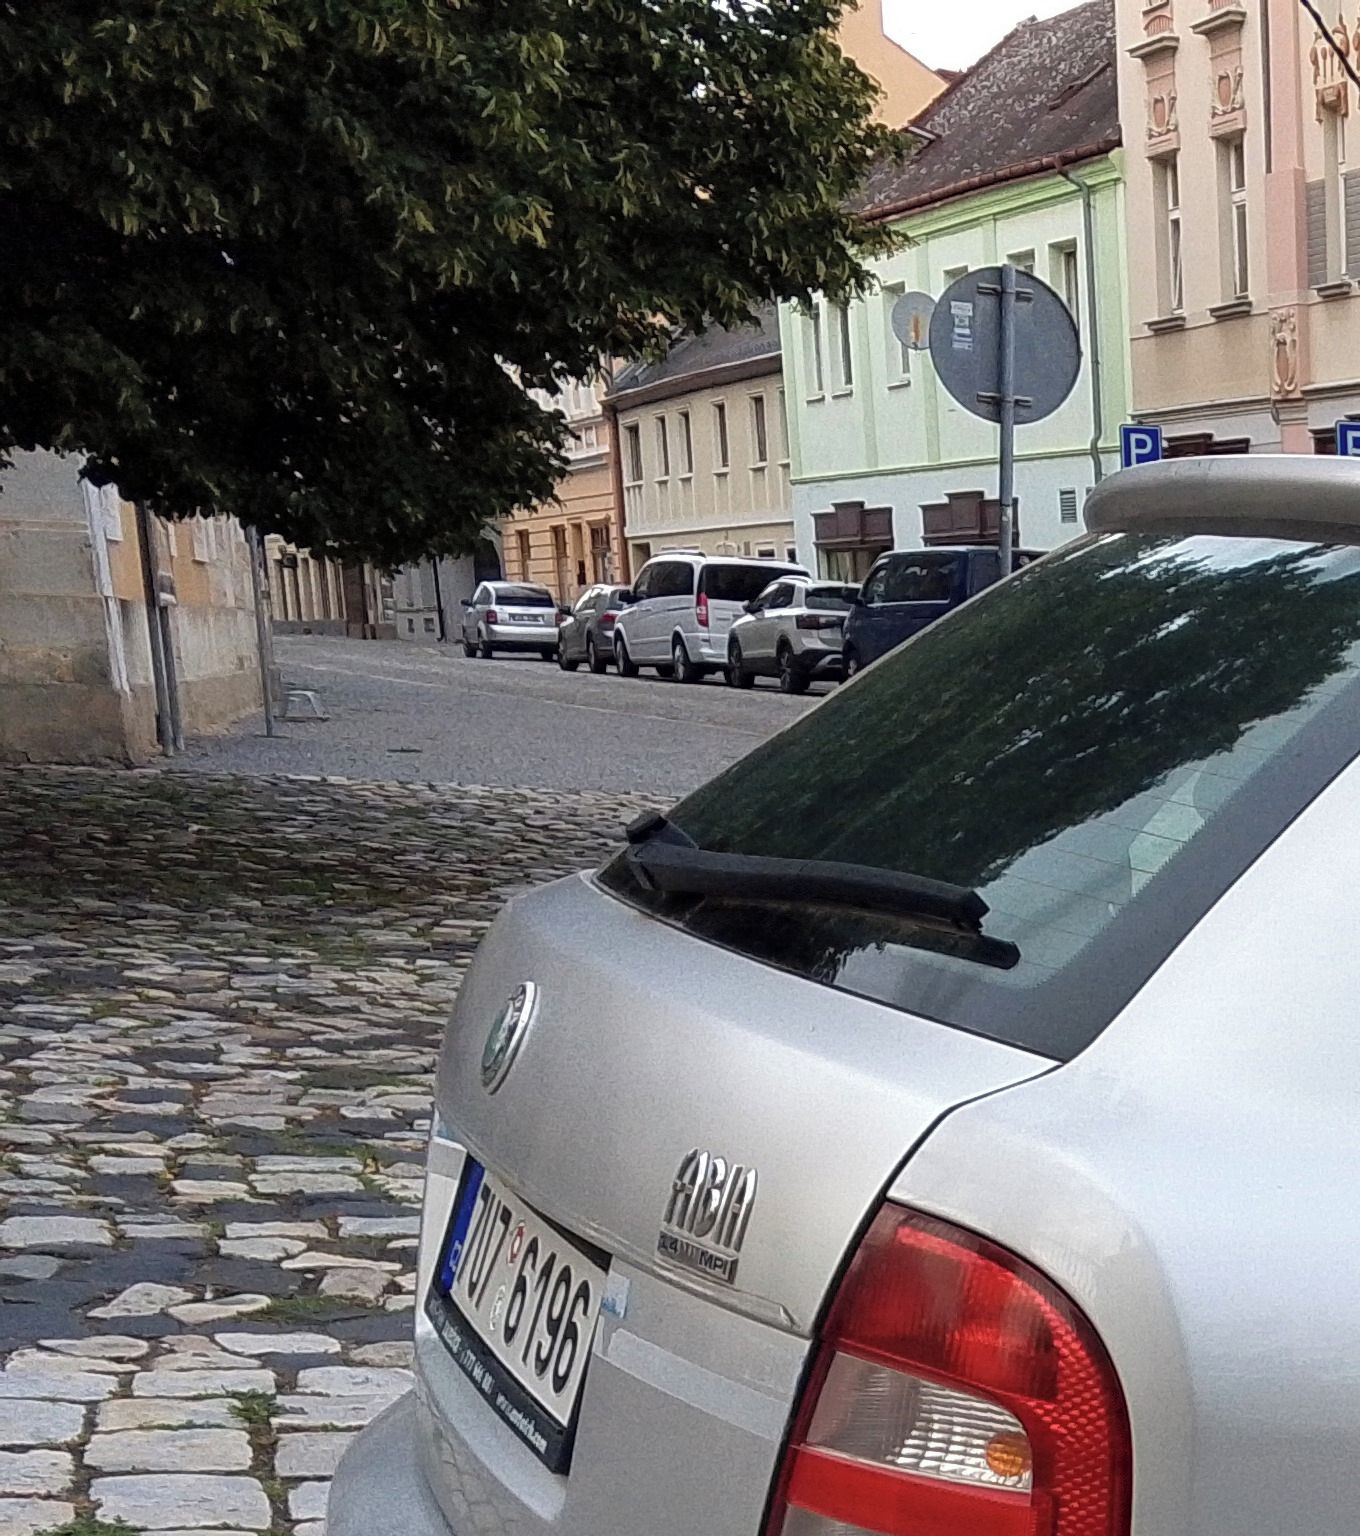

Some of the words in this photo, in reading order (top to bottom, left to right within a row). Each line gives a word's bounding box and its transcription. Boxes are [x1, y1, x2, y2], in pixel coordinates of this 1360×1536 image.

[1129, 432, 1153, 465] P
[699, 1250, 729, 1276] MPI
[456, 1182, 513, 1309] 7U7
[503, 1235, 592, 1394] 6196
